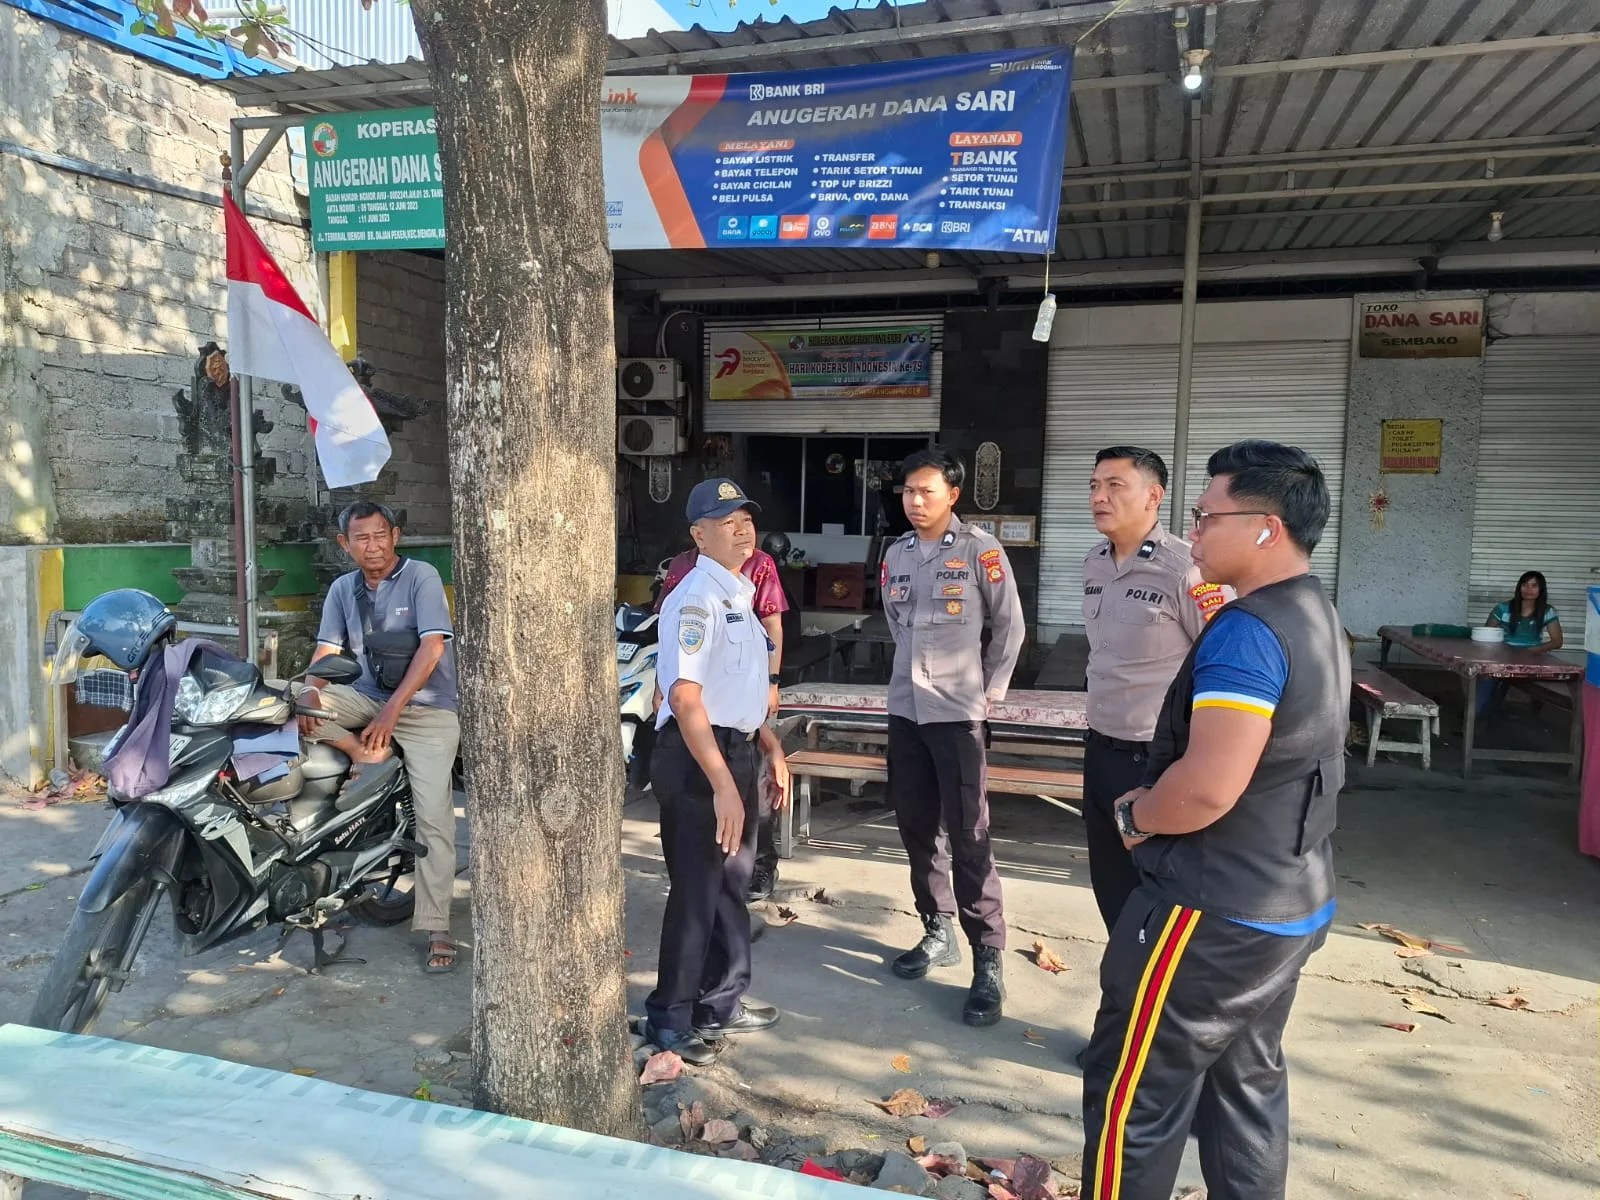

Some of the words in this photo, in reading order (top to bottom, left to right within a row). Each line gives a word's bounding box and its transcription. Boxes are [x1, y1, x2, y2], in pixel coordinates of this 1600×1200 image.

[765, 85, 800, 98] BANK
[804, 83, 825, 96] BRI
[603, 88, 638, 104] ink
[747, 102, 876, 126] ANUGERAH
[882, 95, 948, 117] DANA
[955, 90, 1016, 112] SARI
[357, 118, 436, 139] KOPERAS
[955, 133, 1017, 145] LAYANAN
[724, 140, 789, 150] MELAYANI
[722, 156, 753, 165] BAYAR
[755, 154, 794, 164] LISTRIK
[821, 153, 876, 162] TRANSFER
[950, 151, 1018, 165] TBANK
[313, 157, 388, 188] ANUGERAH
[391, 153, 431, 184] DANA
[721, 168, 752, 178] BAYAR
[754, 167, 799, 177] TELEPON
[821, 166, 851, 175] TARIK
[853, 166, 887, 175] SETOR
[890, 166, 923, 175] TUNAI
[951, 173, 984, 182] SETOR
[987, 174, 1018, 183] TUNAI
[720, 181, 751, 190] BAYAR
[753, 180, 792, 189] CICILAN
[819, 180, 839, 188] TOP
[841, 180, 856, 188] UP
[858, 179, 893, 188] BRIZZI
[950, 187, 980, 196] TARIK
[982, 187, 1014, 197] TUNAI
[719, 194, 740, 203] BELI
[742, 193, 774, 202] PULSA
[818, 193, 851, 202] BRIVA,
[853, 193, 878, 202] OVO,
[880, 193, 909, 201] DANA
[948, 200, 1006, 210] TRANSAKSI
[879, 221, 896, 230] BNI
[912, 223, 933, 232] BCA
[952, 222, 970, 232] BRI
[813, 229, 831, 237] OVO
[1012, 228, 1048, 244] ATM
[1366, 304, 1398, 312] TOKO
[1365, 313, 1420, 328] DANA
[1429, 311, 1479, 326] SARI
[1381, 336, 1458, 346] SEMBAKO
[936, 570, 969, 580] POLRI
[1125, 588, 1164, 605] POLRI
[1202, 596, 1222, 607] BALI
